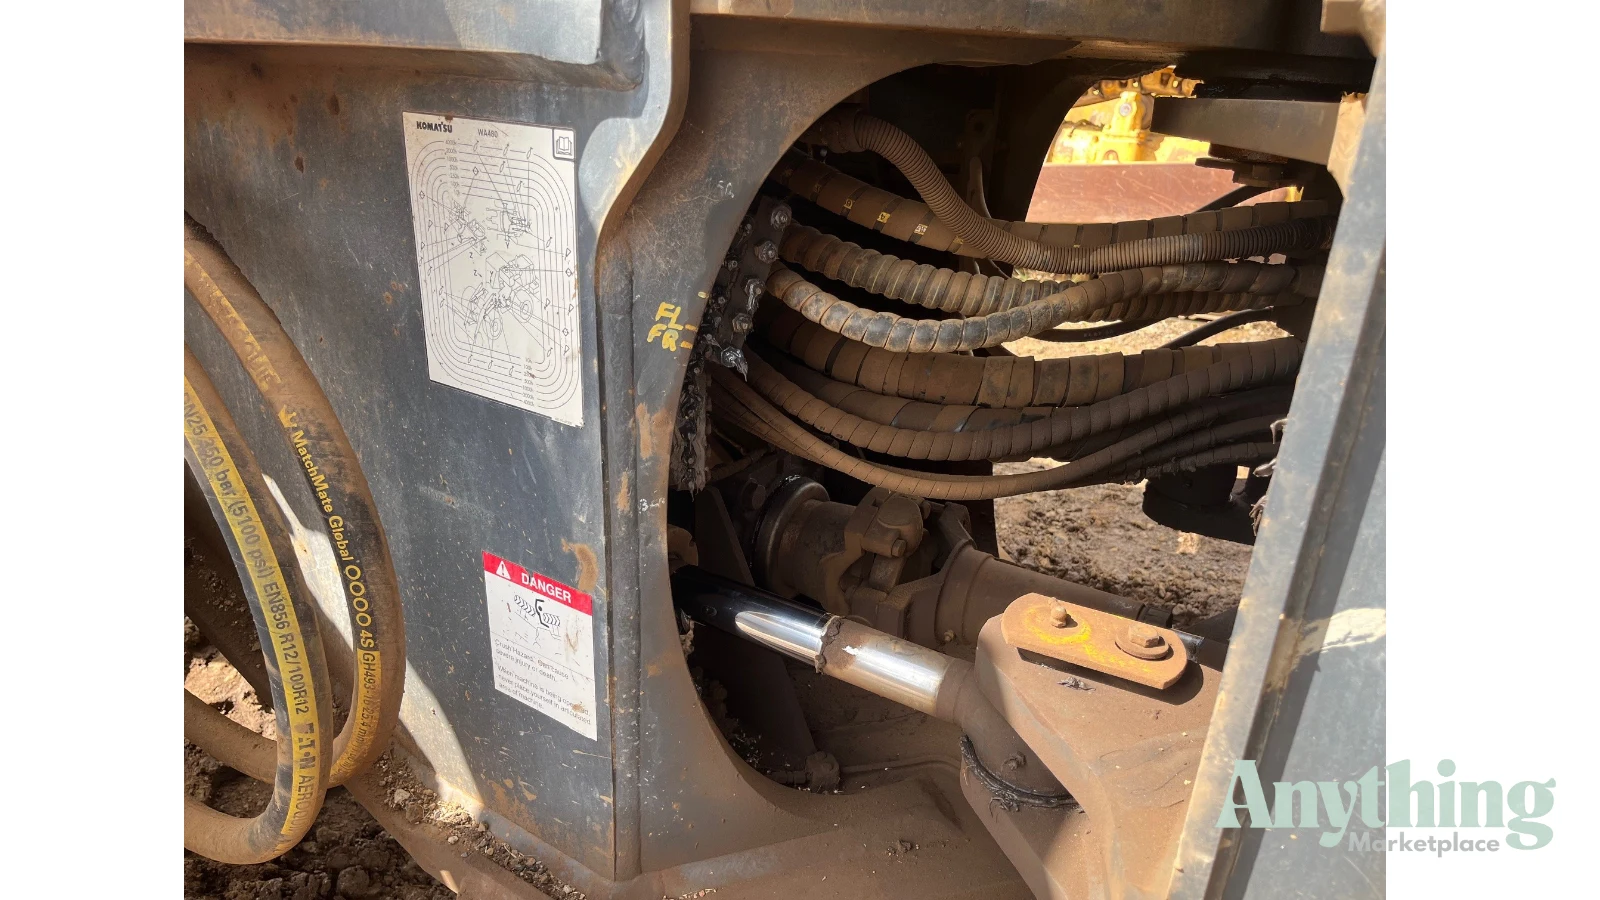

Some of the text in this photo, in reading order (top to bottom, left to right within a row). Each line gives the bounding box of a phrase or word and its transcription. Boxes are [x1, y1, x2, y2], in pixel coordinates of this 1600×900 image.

[416, 121, 499, 138] KOMATSU WA480
[291, 430, 333, 513] MatchMate
[328, 515, 355, 561] Global
[360, 629, 375, 649] 4S
[215, 469, 237, 496] bar
[227, 500, 261, 545] (5100
[247, 548, 275, 579] psi)
[263, 582, 290, 630] EN856
[279, 632, 310, 715] R12/100R12
[521, 572, 572, 604] DANGER
[495, 639, 511, 652] Crush
[496, 648, 515, 661] severe
[515, 656, 531, 670] injury
[498, 665, 514, 678] When
[514, 674, 539, 689] machine
[545, 688, 562, 703] being
[514, 681, 530, 693] place
[530, 690, 553, 704] yourself
[553, 699, 560, 709] in
